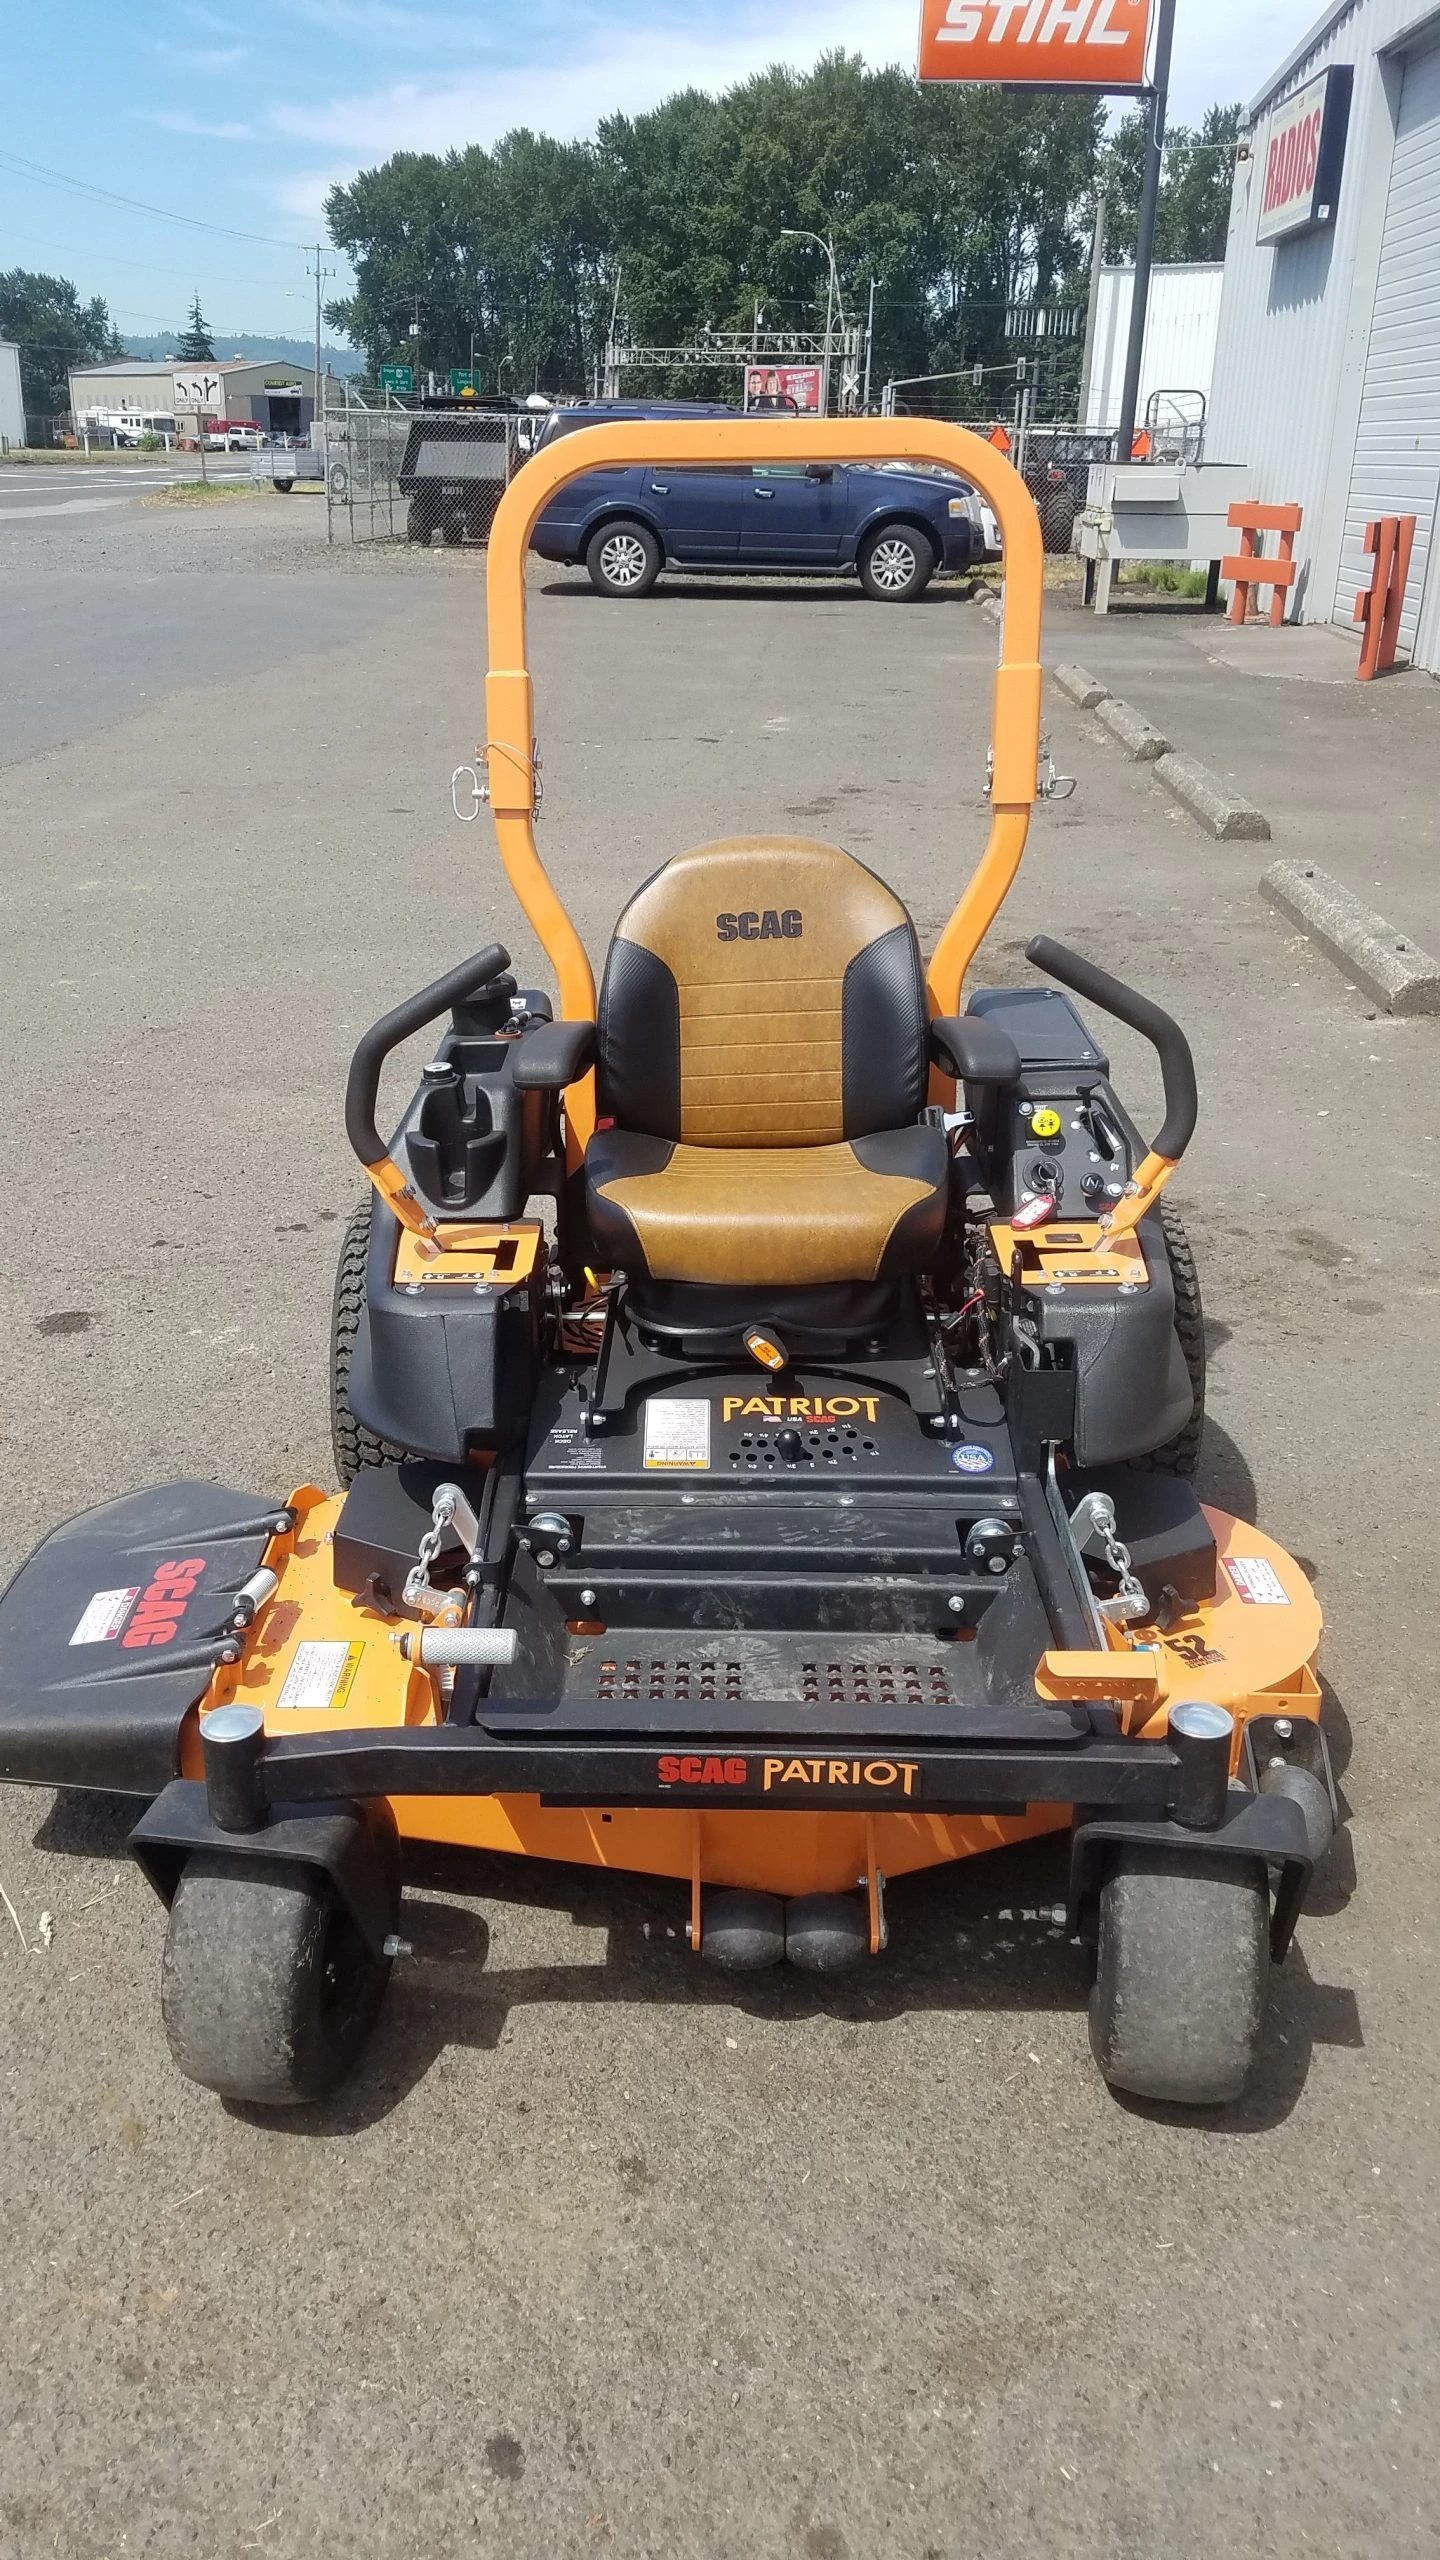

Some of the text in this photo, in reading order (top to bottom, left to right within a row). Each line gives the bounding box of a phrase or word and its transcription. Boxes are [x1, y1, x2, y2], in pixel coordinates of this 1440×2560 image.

[935, 0, 1130, 44] STIHL
[1263, 107, 1321, 215] RADIOS
[716, 910, 803, 941] SCAG
[723, 1397, 879, 1423] PATRIOT
[806, 1415, 835, 1423] SCAG
[109, 1601, 131, 1631] DANGER
[121, 1558, 207, 1649] SCAG
[1164, 1634, 1218, 1659] 52
[337, 1662, 354, 1693] WARNING
[657, 1756, 919, 1796] SCAG PATRIOT
